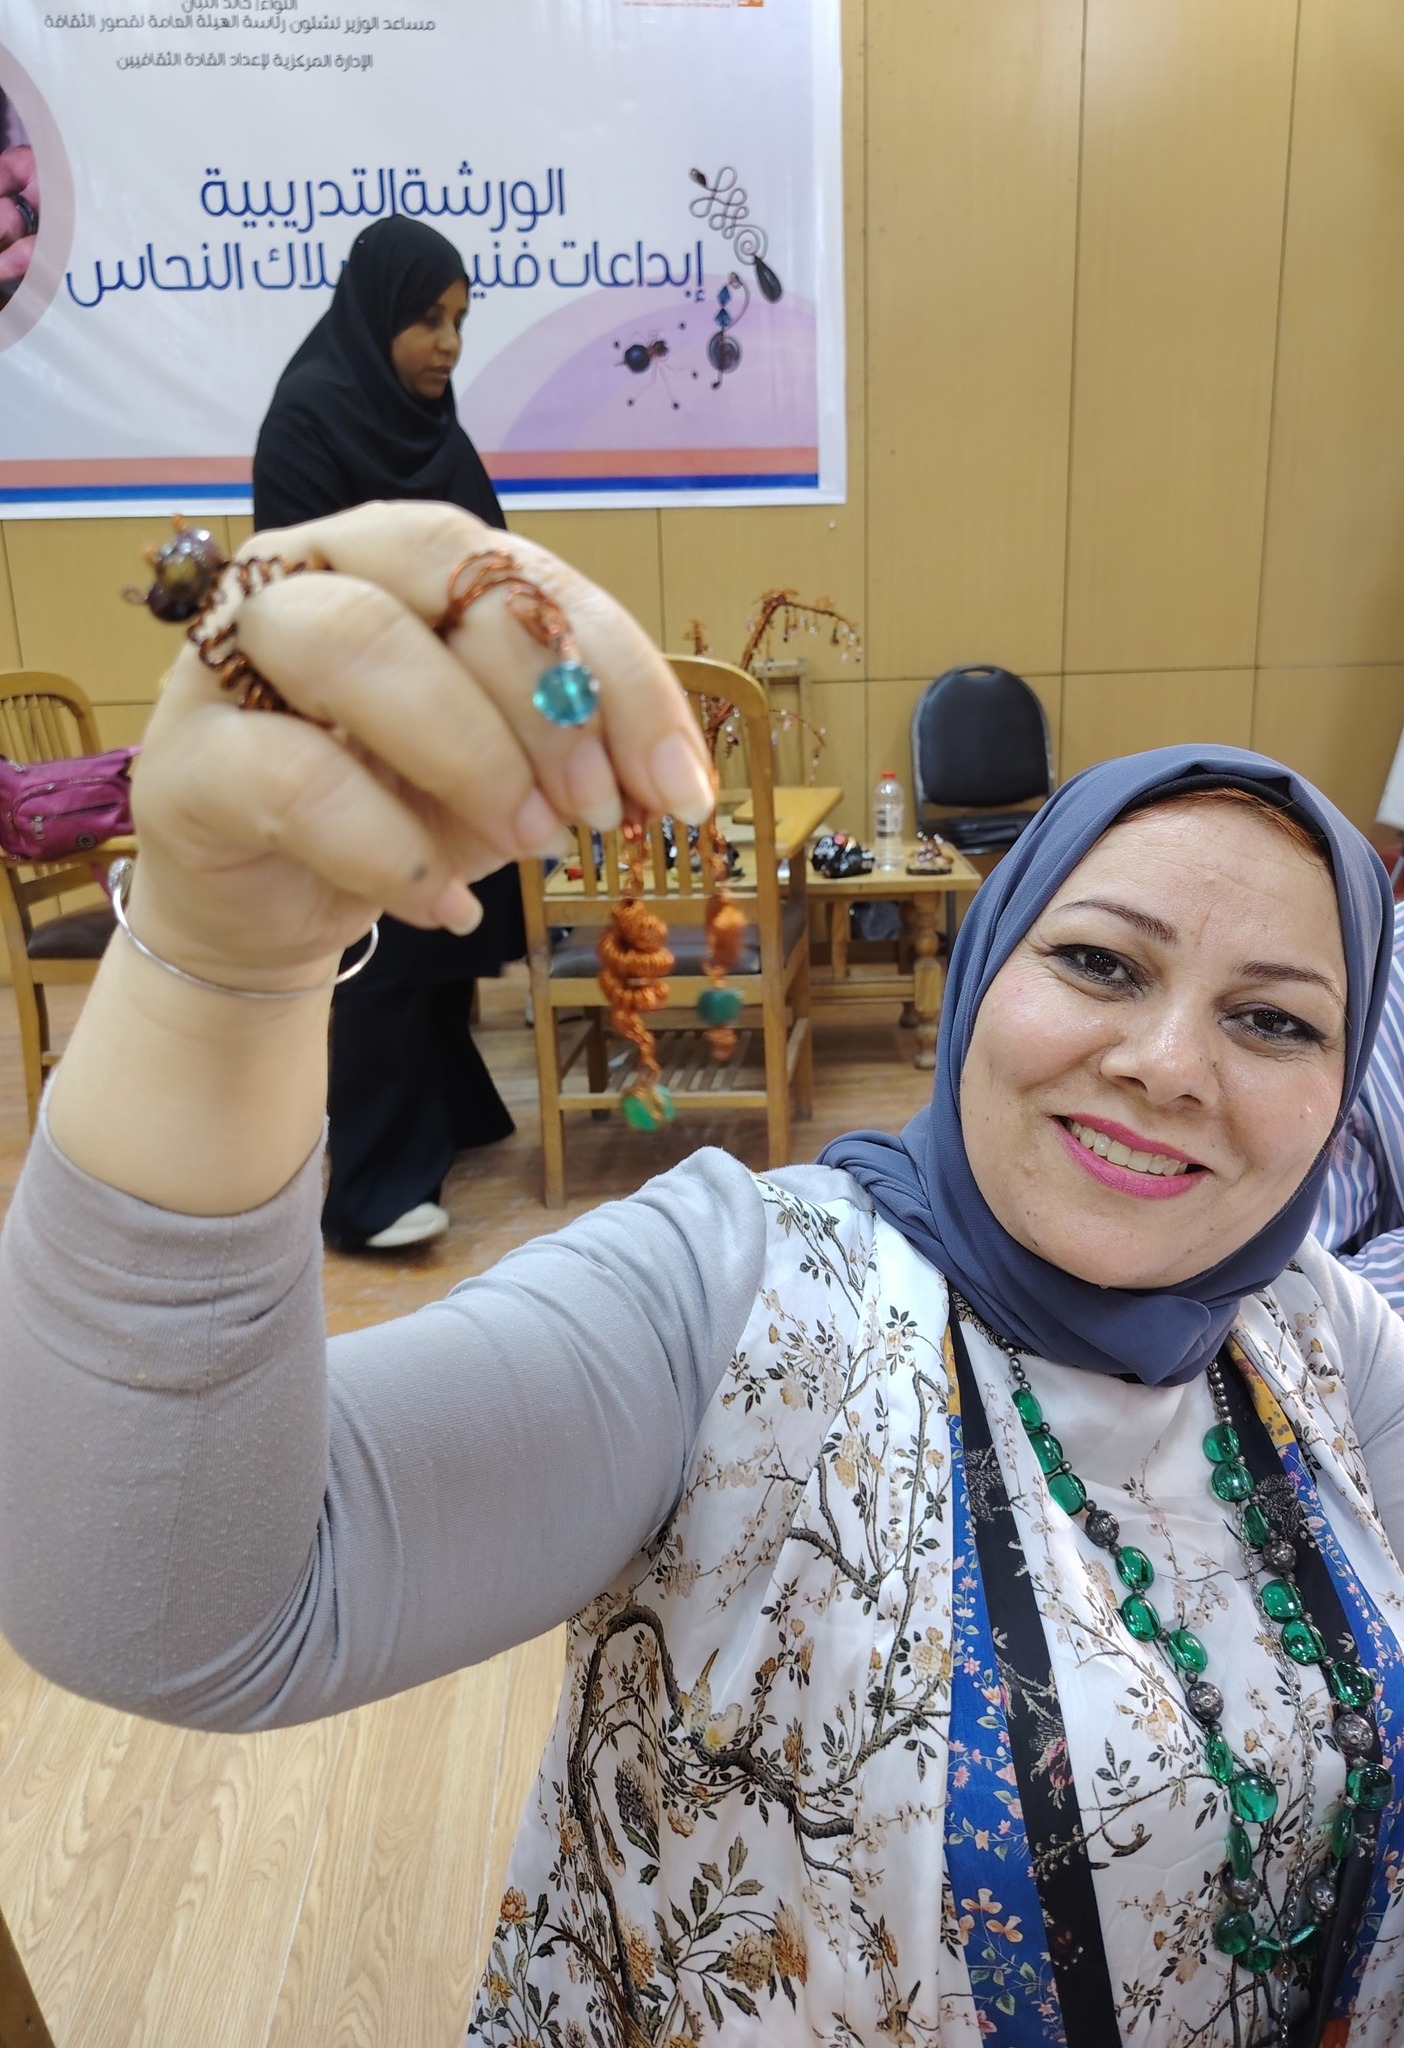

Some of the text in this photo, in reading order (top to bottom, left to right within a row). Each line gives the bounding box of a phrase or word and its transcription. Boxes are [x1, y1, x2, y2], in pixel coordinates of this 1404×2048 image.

[43, 13, 437, 35] مساعد الوزير لشئون رئاسة الهيئة العامة لقصور الثقافة
[116, 51, 374, 72] الإدارة المركزية لإعداد القادة الثقافيين
[199, 160, 566, 234] الورشة التدريبية
[65, 241, 245, 309] النحاس
[468, 240, 541, 300] فني
[548, 239, 706, 304] إبداعات
